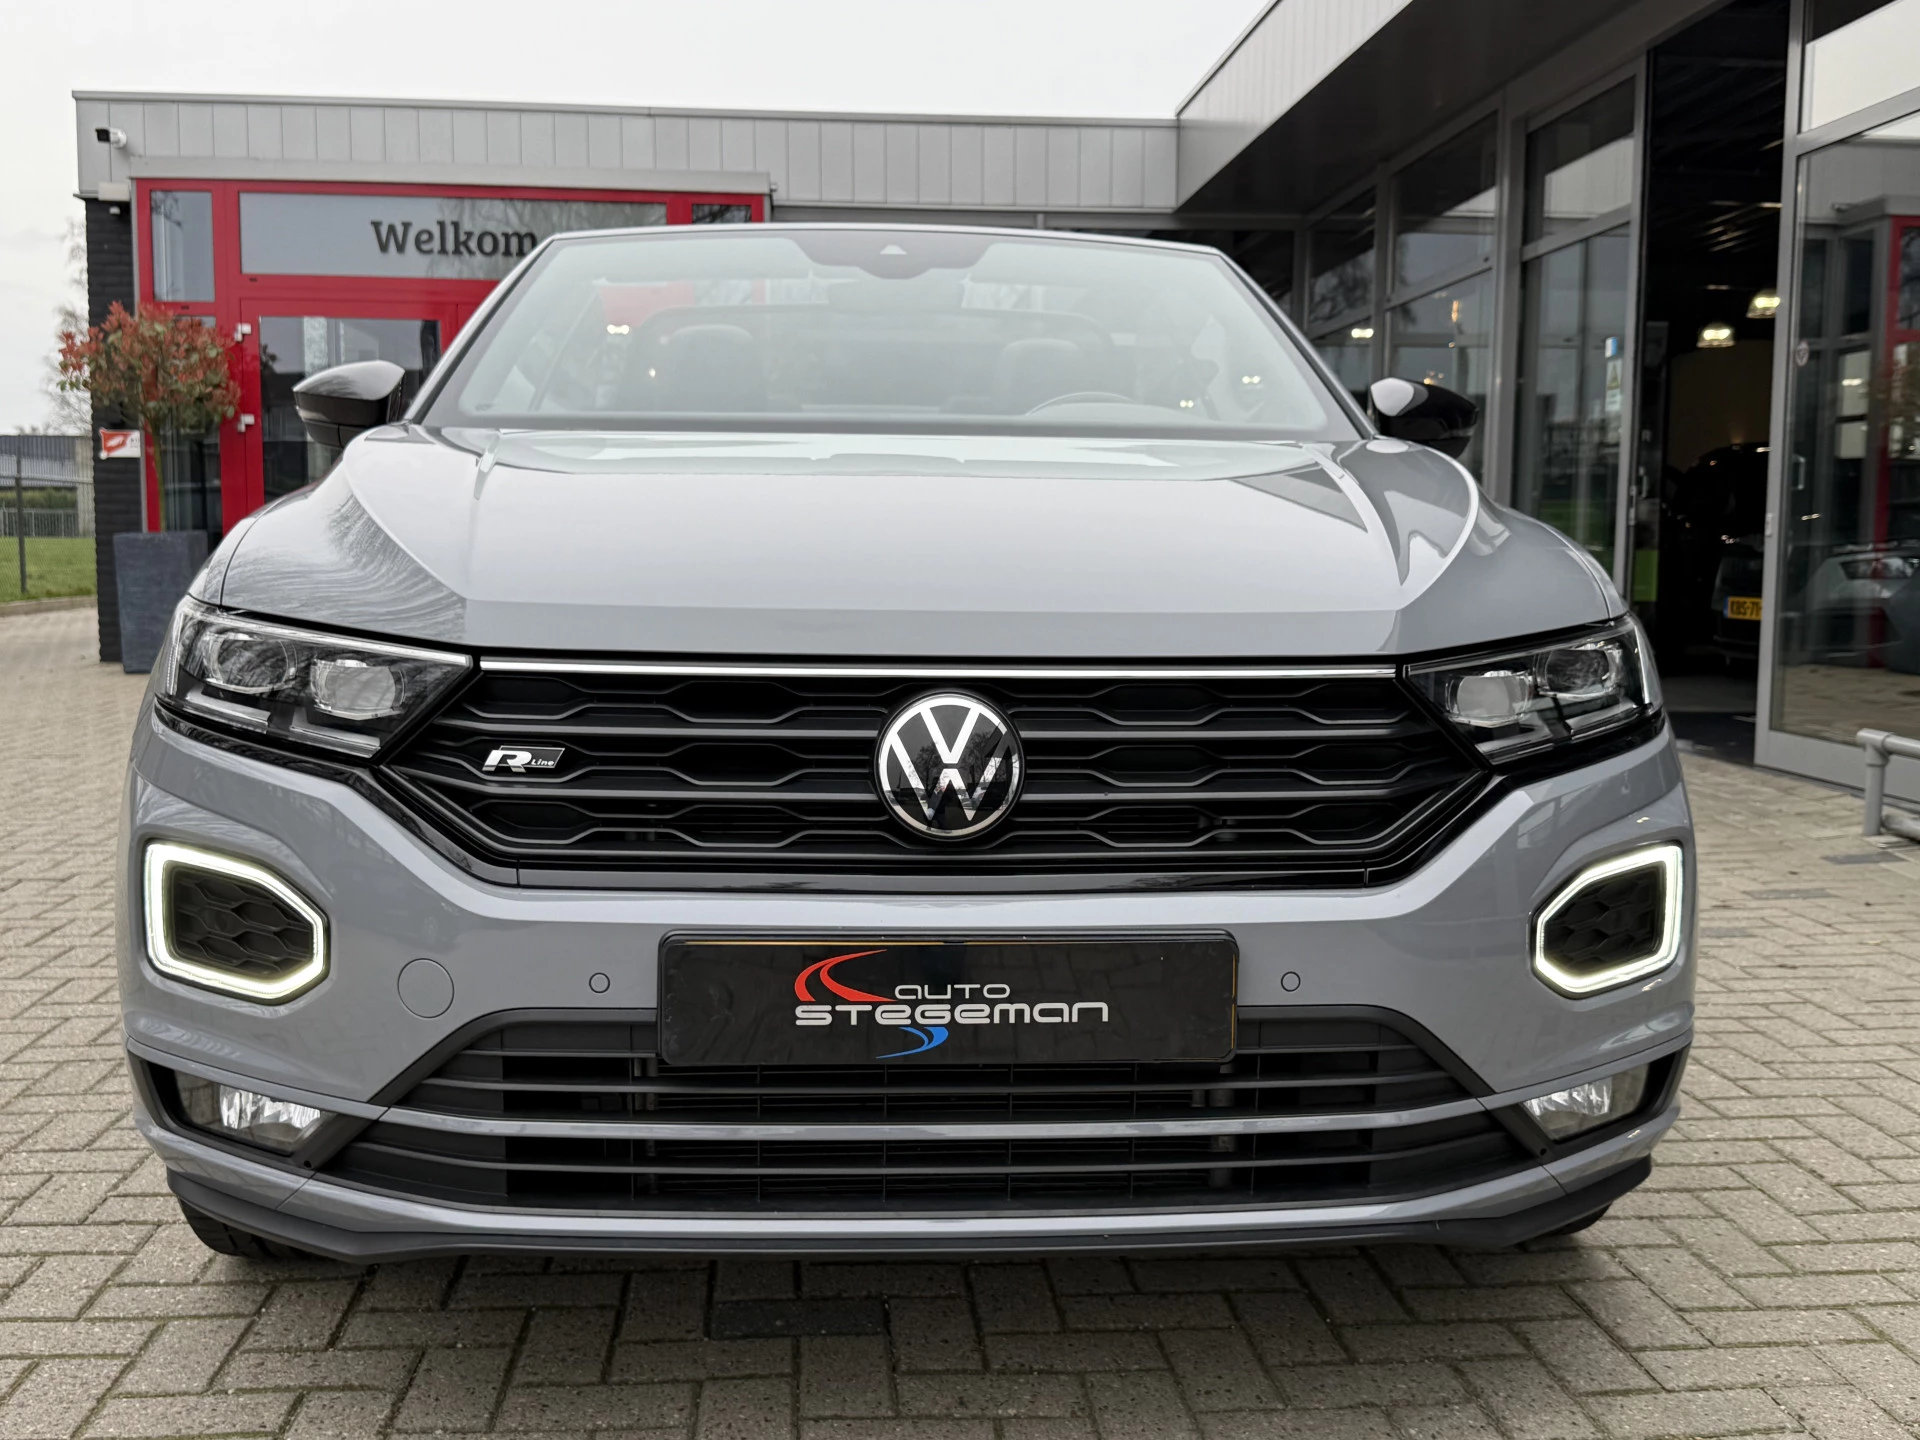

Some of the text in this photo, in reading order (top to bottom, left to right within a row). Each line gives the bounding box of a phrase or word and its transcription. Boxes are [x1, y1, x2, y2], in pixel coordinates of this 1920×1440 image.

[370, 219, 538, 257] Welkom
[482, 749, 555, 773] R Line
